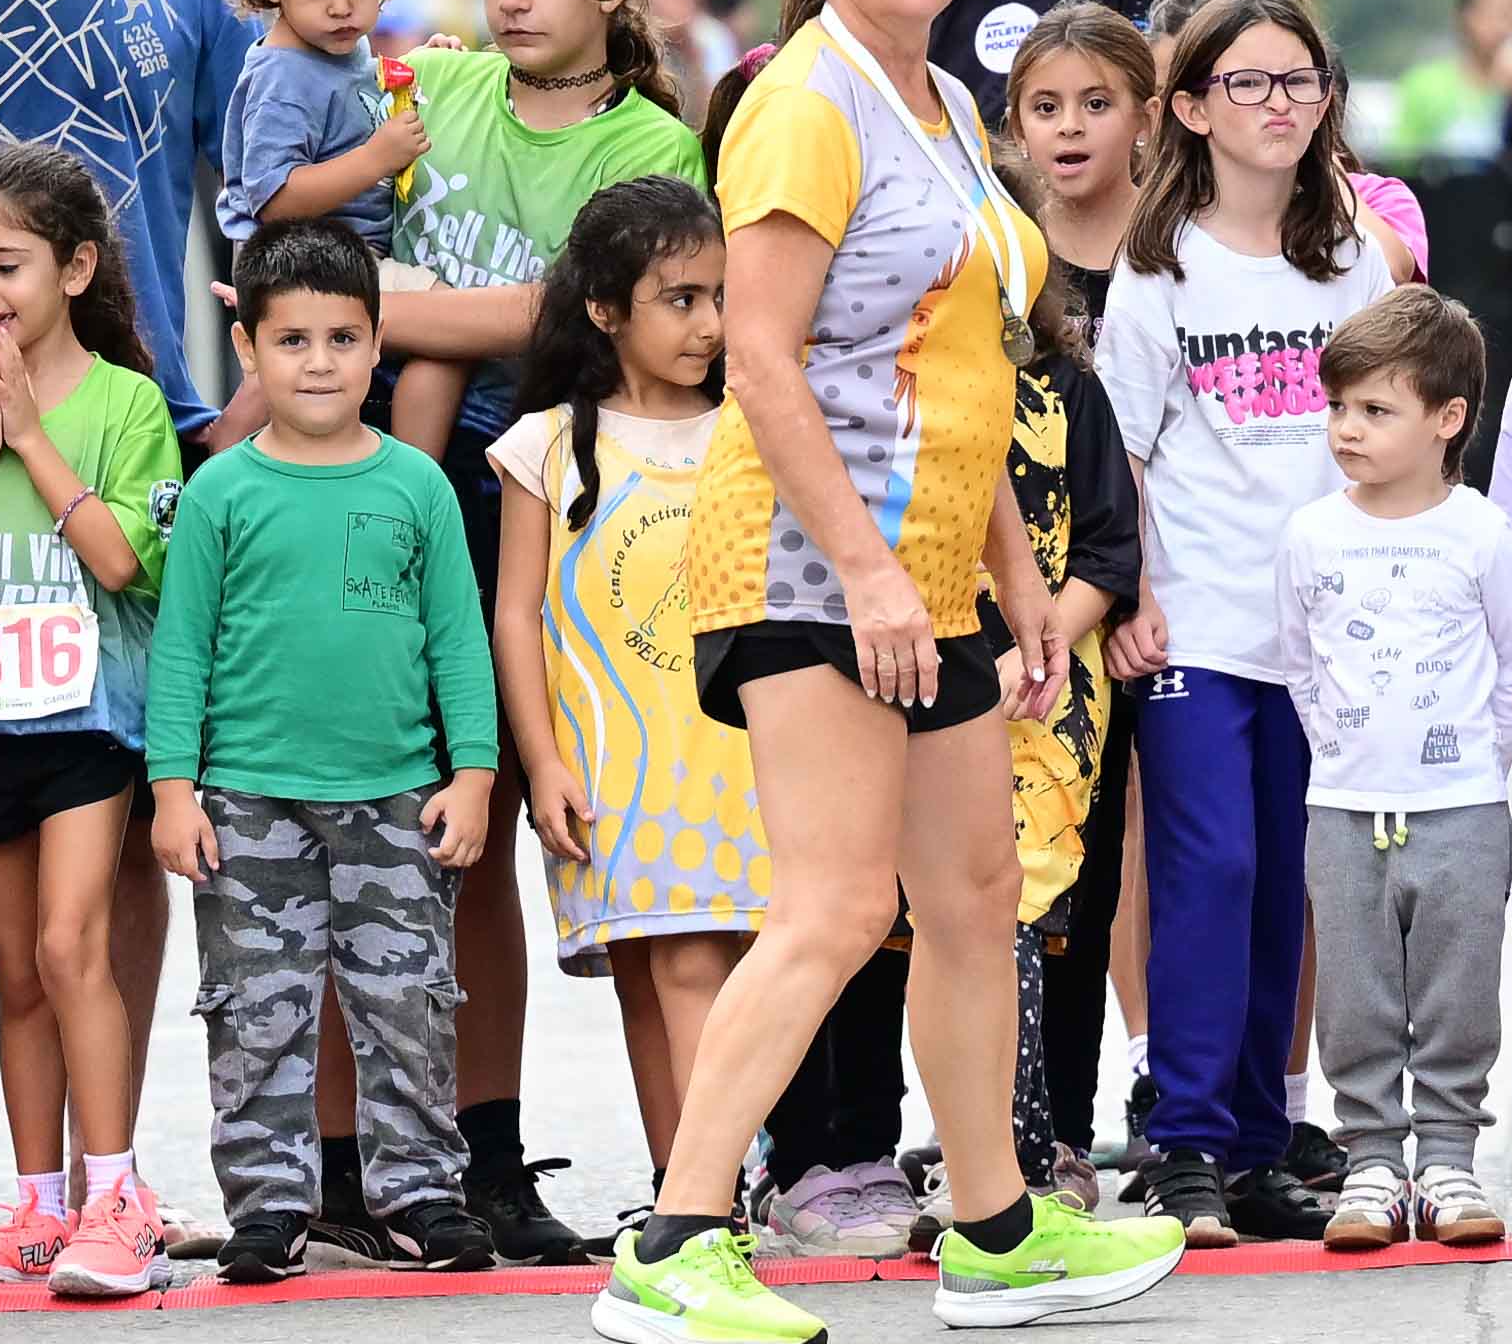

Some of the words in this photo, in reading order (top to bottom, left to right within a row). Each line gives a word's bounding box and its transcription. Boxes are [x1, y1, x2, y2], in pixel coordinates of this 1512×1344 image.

[123, 20, 157, 44] 42K
[128, 37, 164, 62] ROS
[136, 54, 169, 78] 2018
[610, 547, 625, 608] Centro
[622, 528, 638, 548] de
[346, 576, 386, 599] SKATE
[624, 630, 682, 673] BELL
[1371, 647, 1402, 662] YEAH
[18, 1235, 66, 1272] FILA
